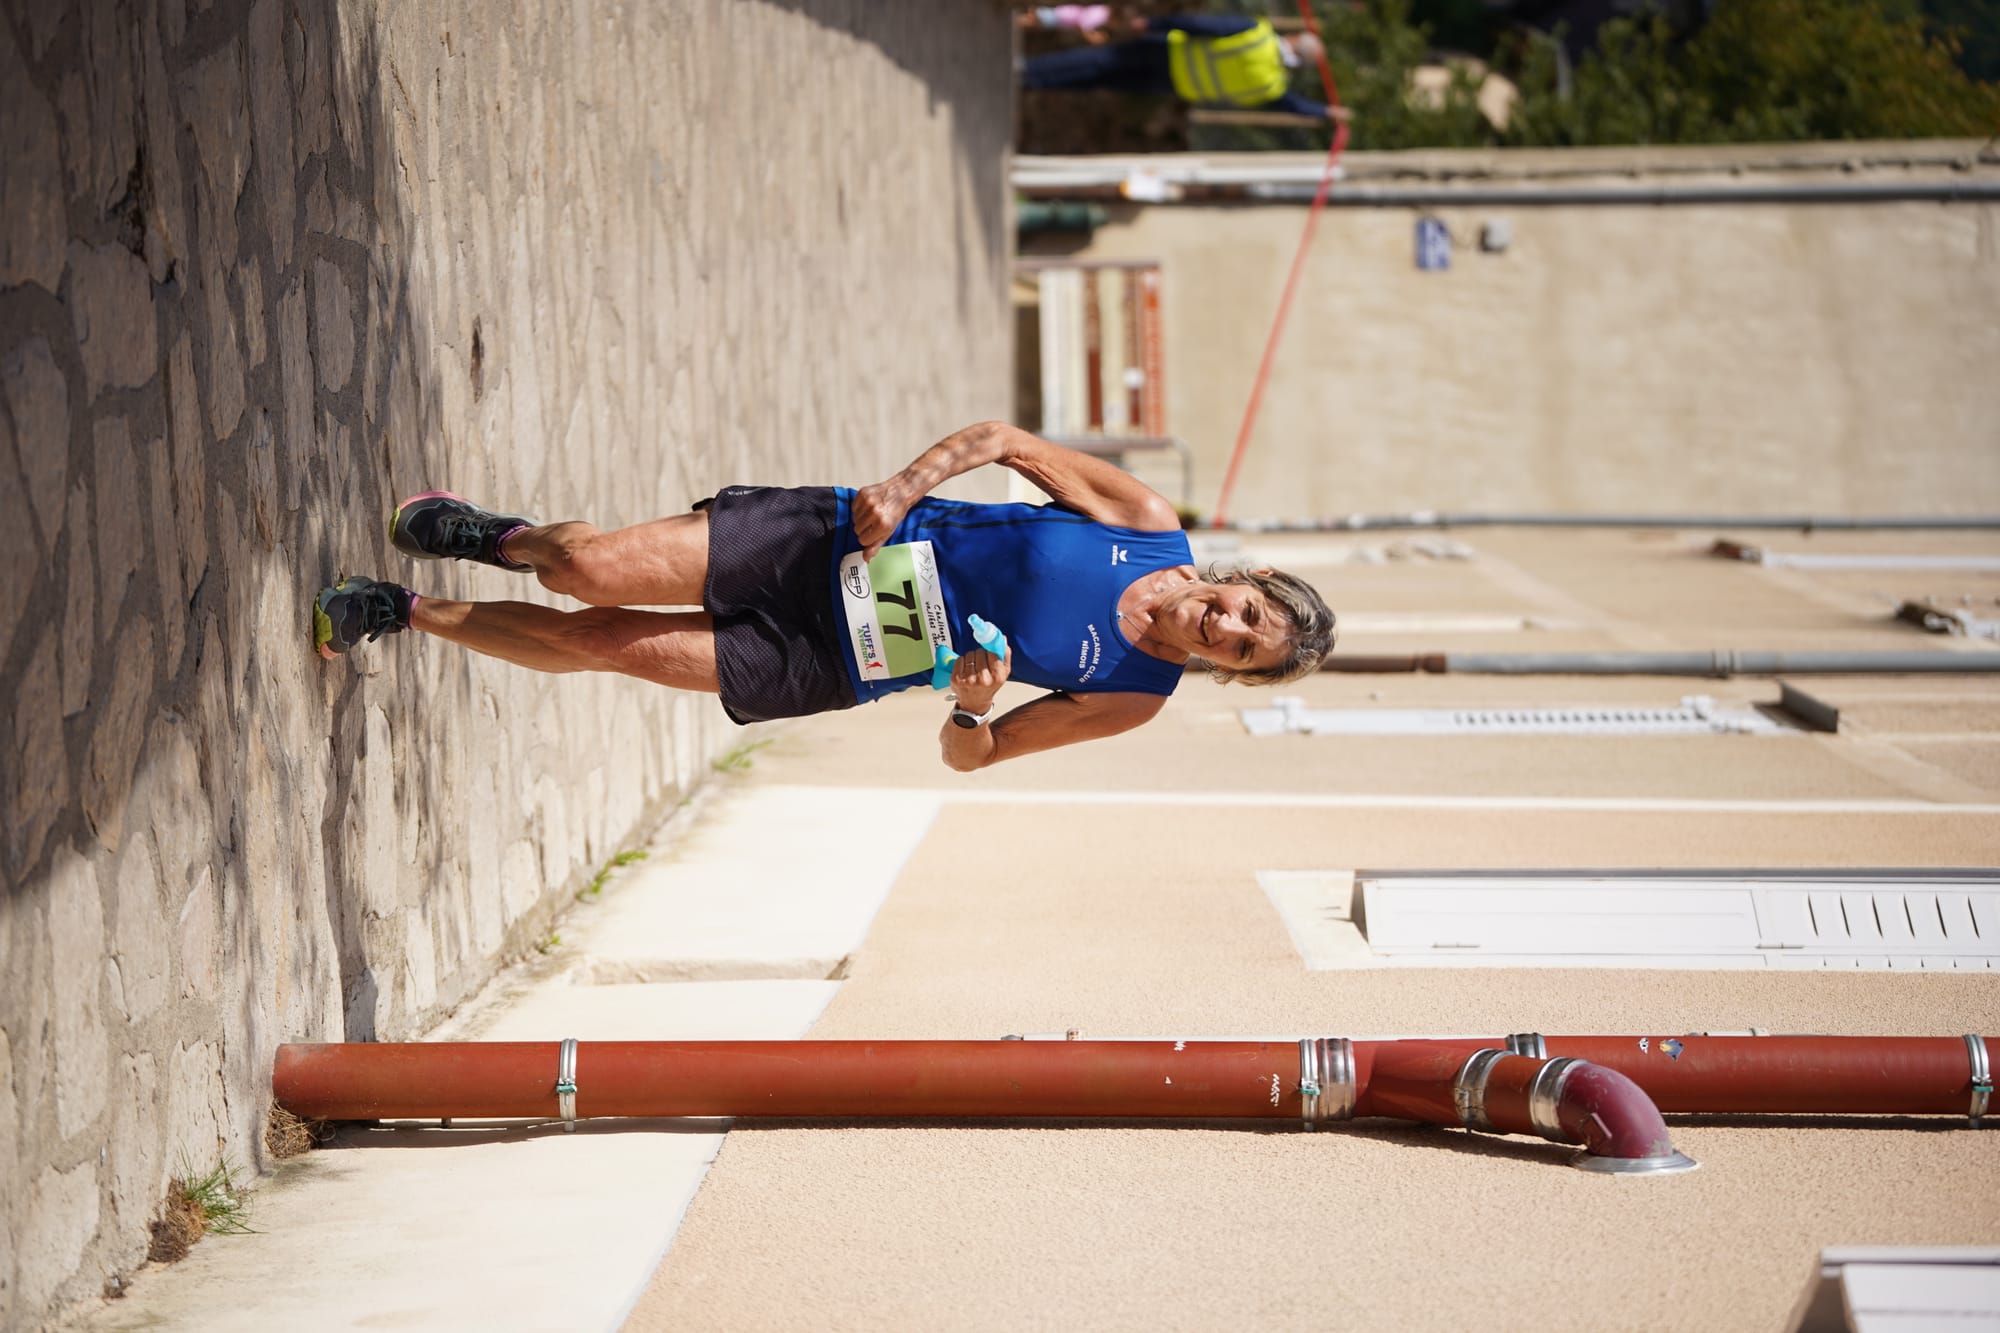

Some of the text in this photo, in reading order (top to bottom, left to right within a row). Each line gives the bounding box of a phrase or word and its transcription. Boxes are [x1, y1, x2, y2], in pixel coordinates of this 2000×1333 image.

[850, 566, 862, 594] BFP
[876, 580, 923, 641] 77
[934, 604, 946, 642] Challenge
[862, 623, 876, 659] TUFF'S
[1079, 624, 1101, 683] MACADAM CLUB
